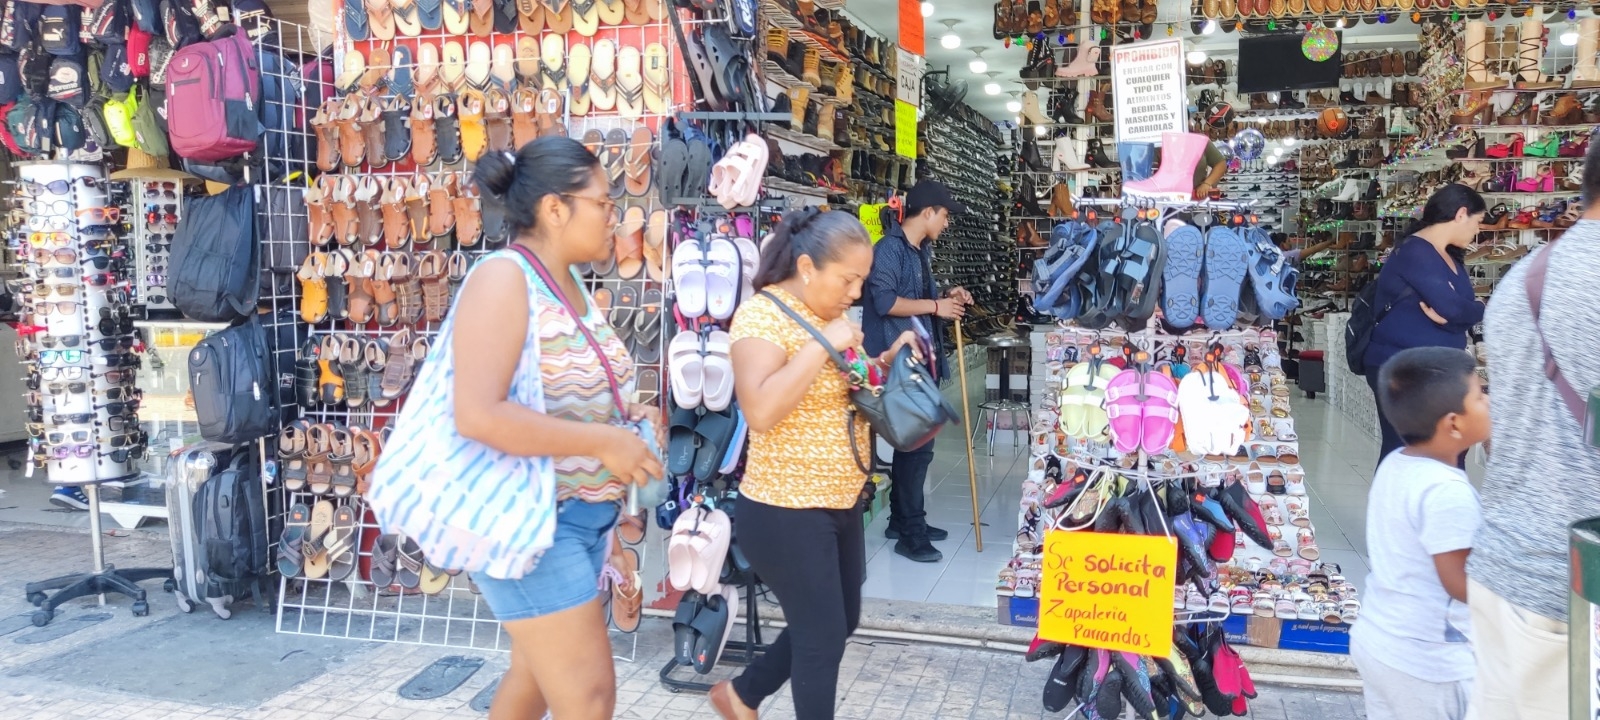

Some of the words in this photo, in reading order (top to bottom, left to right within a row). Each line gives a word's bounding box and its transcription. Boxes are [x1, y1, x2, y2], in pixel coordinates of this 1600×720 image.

[1116, 45, 1178, 64] PROHIBIDO
[1122, 65, 1153, 75] ENTRAR
[1155, 63, 1172, 72] CON
[901, 74, 915, 93] CAJA
[1126, 73, 1170, 85] CUALQUIER
[1134, 86, 1152, 94] TIPO
[1126, 93, 1172, 105] ALIMENTOS
[1125, 113, 1168, 124] MASCOTAS
[1170, 112, 1176, 120] Y
[1128, 122, 1174, 134] CARRIOLAS
[1048, 541, 1074, 570] Se
[1073, 624, 1151, 648] Parrandas
